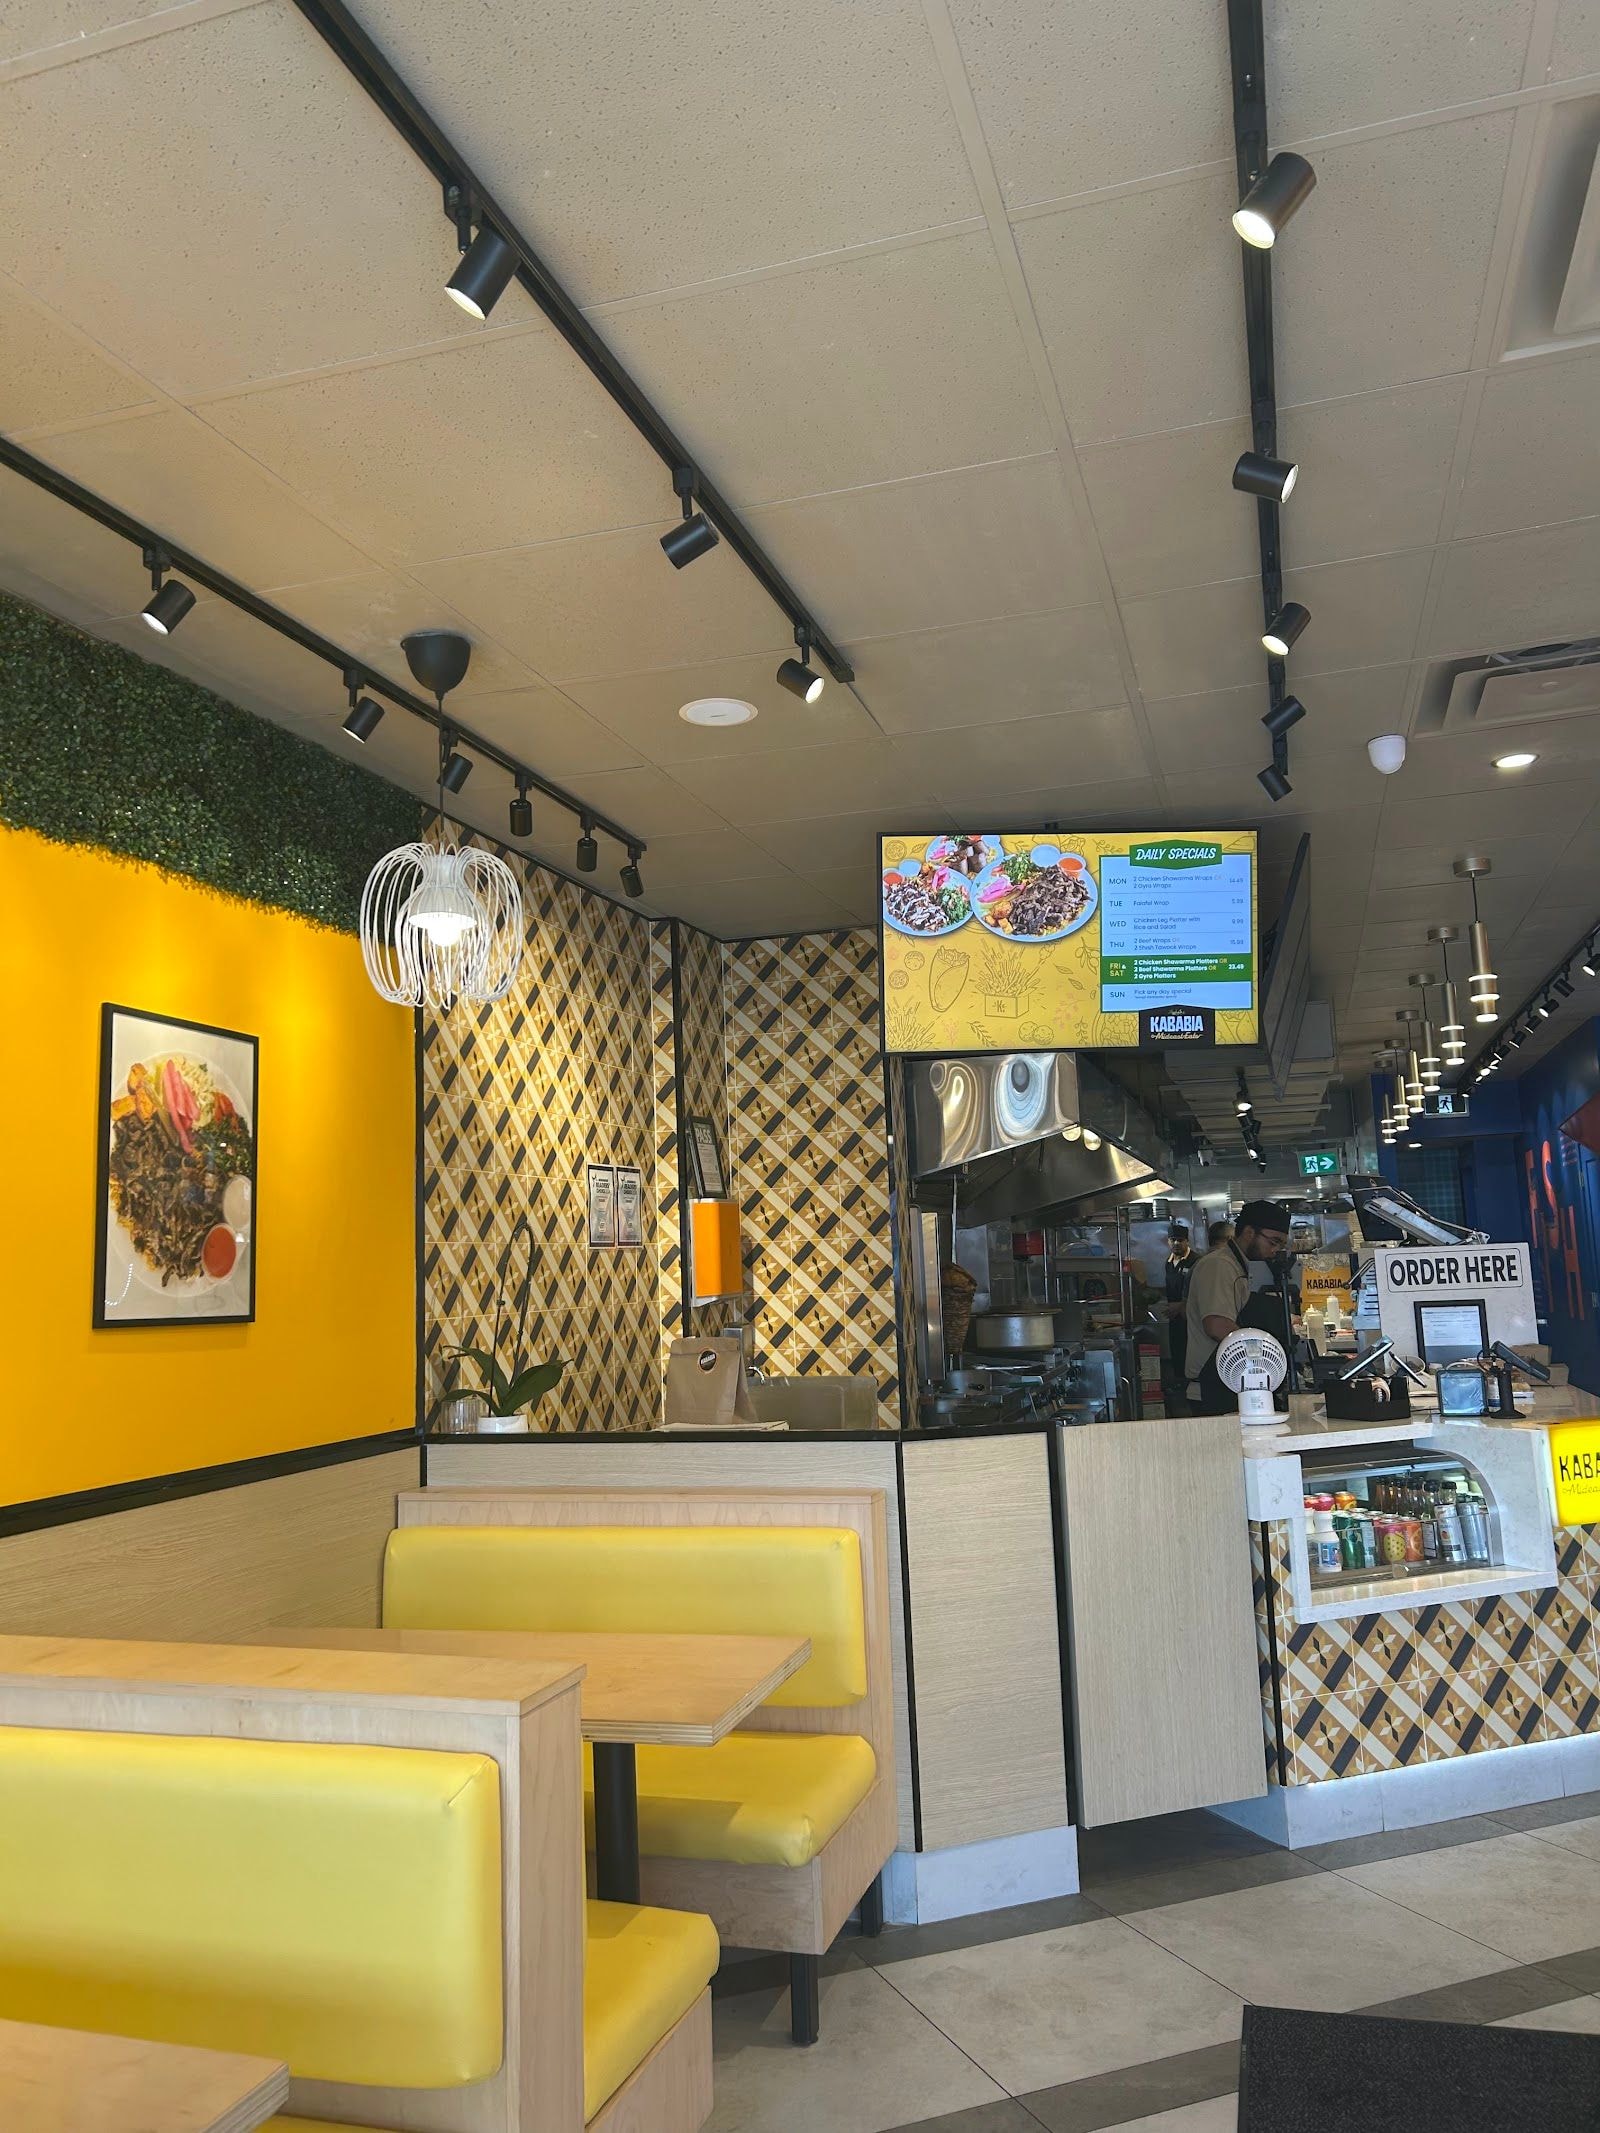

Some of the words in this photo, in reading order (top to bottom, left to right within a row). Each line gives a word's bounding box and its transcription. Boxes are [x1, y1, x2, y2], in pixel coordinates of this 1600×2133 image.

[1136, 849, 1166, 860] DAILY
[1168, 848, 1216, 859] SPECIALS
[1150, 1016, 1204, 1032] KABABIA
[695, 1127, 712, 1144] PASS
[1390, 1258, 1460, 1286] ORDER
[1464, 1254, 1518, 1283] HERE
[1306, 1279, 1343, 1289] KABABIA
